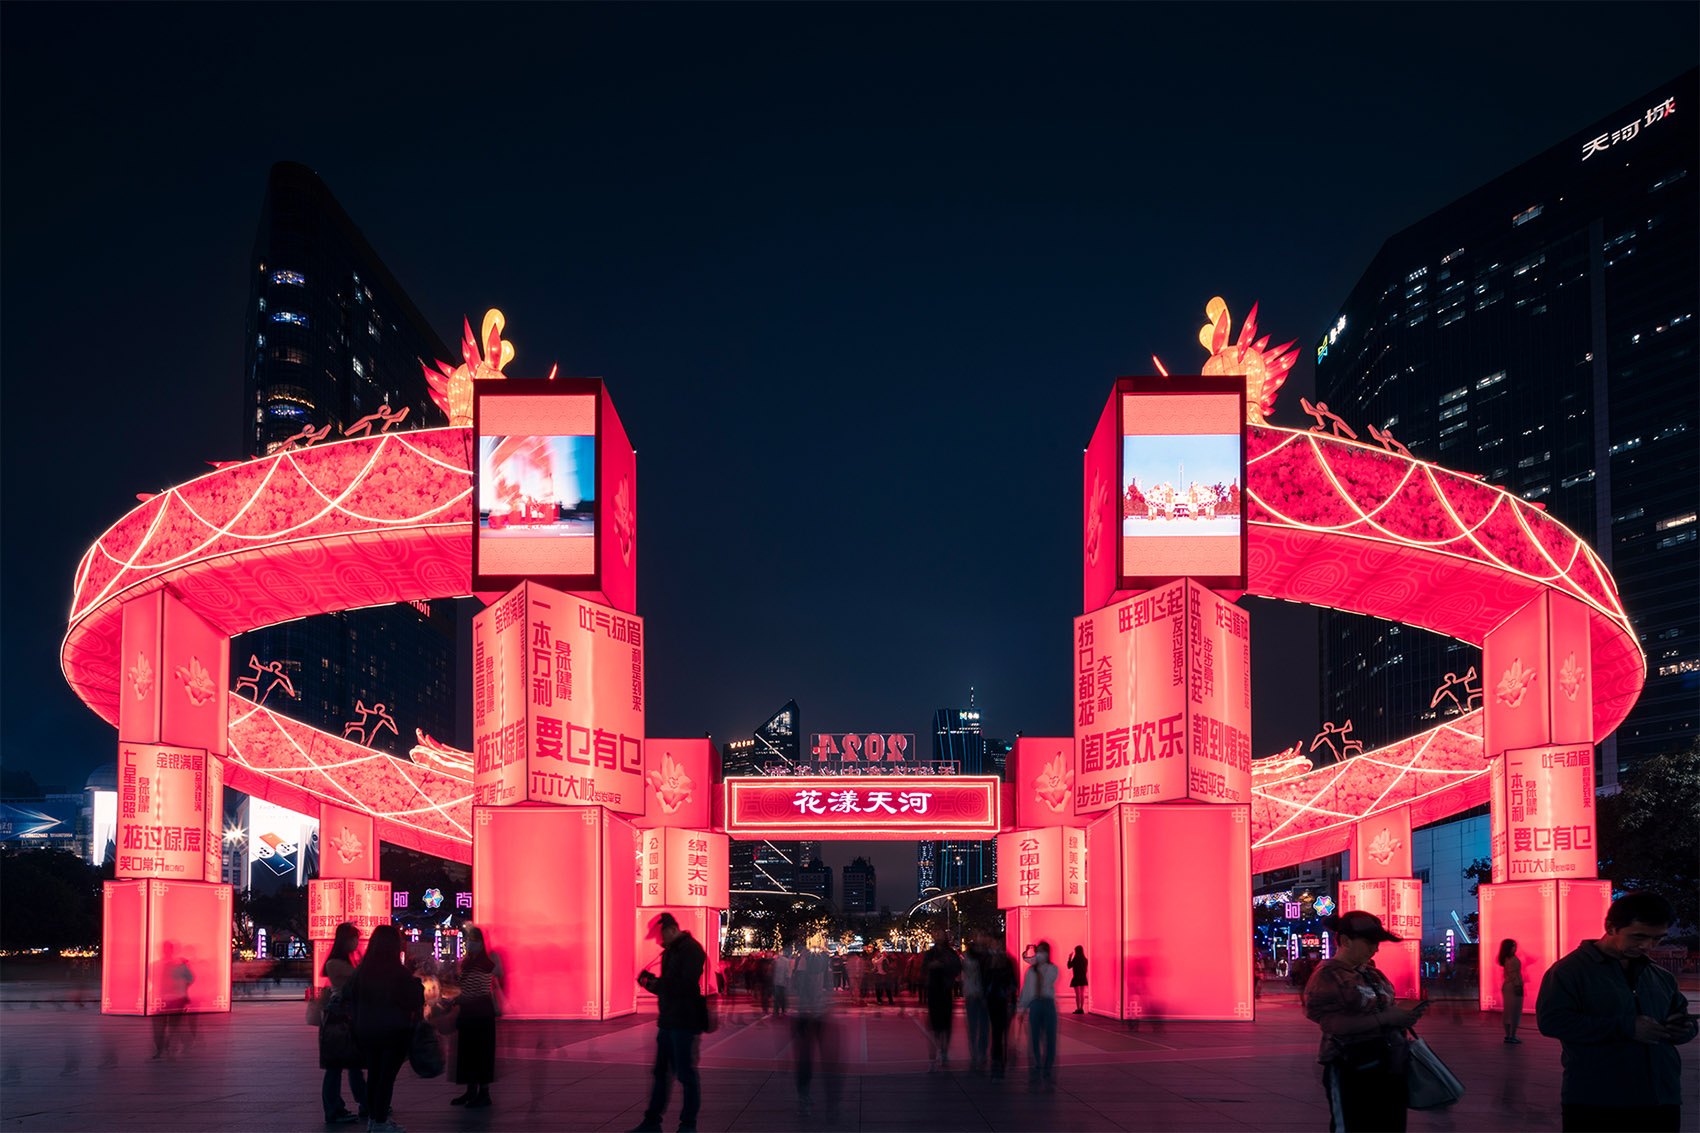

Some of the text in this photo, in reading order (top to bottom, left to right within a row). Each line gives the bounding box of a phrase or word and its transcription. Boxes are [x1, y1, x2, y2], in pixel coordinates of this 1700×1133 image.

[1582, 96, 1676, 161] 天河城
[579, 604, 641, 647] 吐气扬眉
[1118, 585, 1183, 634] 旺到飞起
[532, 600, 552, 707] 一本万利
[1190, 586, 1202, 704] 旺到飞起
[555, 640, 572, 701] 身体健康
[1097, 655, 1112, 712] 大吉大利
[156, 752, 203, 771] 金银满屋
[536, 715, 642, 776] 要乜有乜
[1081, 712, 1184, 775] 阖家欢乐
[1541, 750, 1590, 769] 吐气扬眉
[123, 749, 136, 819] 七星高照
[531, 770, 594, 802] 六六大顺
[792, 789, 932, 814] 花漾天河
[1077, 777, 1132, 808] 步步高升
[1190, 766, 1225, 799] 岁岁平安
[1510, 761, 1524, 823] 一本万利
[123, 824, 201, 852] 掂过碌蔗
[1514, 825, 1592, 852] 要乜有乜
[119, 856, 165, 872] 笑口常开
[648, 837, 659, 895] 公园城区
[688, 839, 708, 897] 绿美天河
[1019, 838, 1040, 896] 公园城区
[1511, 858, 1555, 874] 六六大顺
[456, 892, 472, 908] 尚
